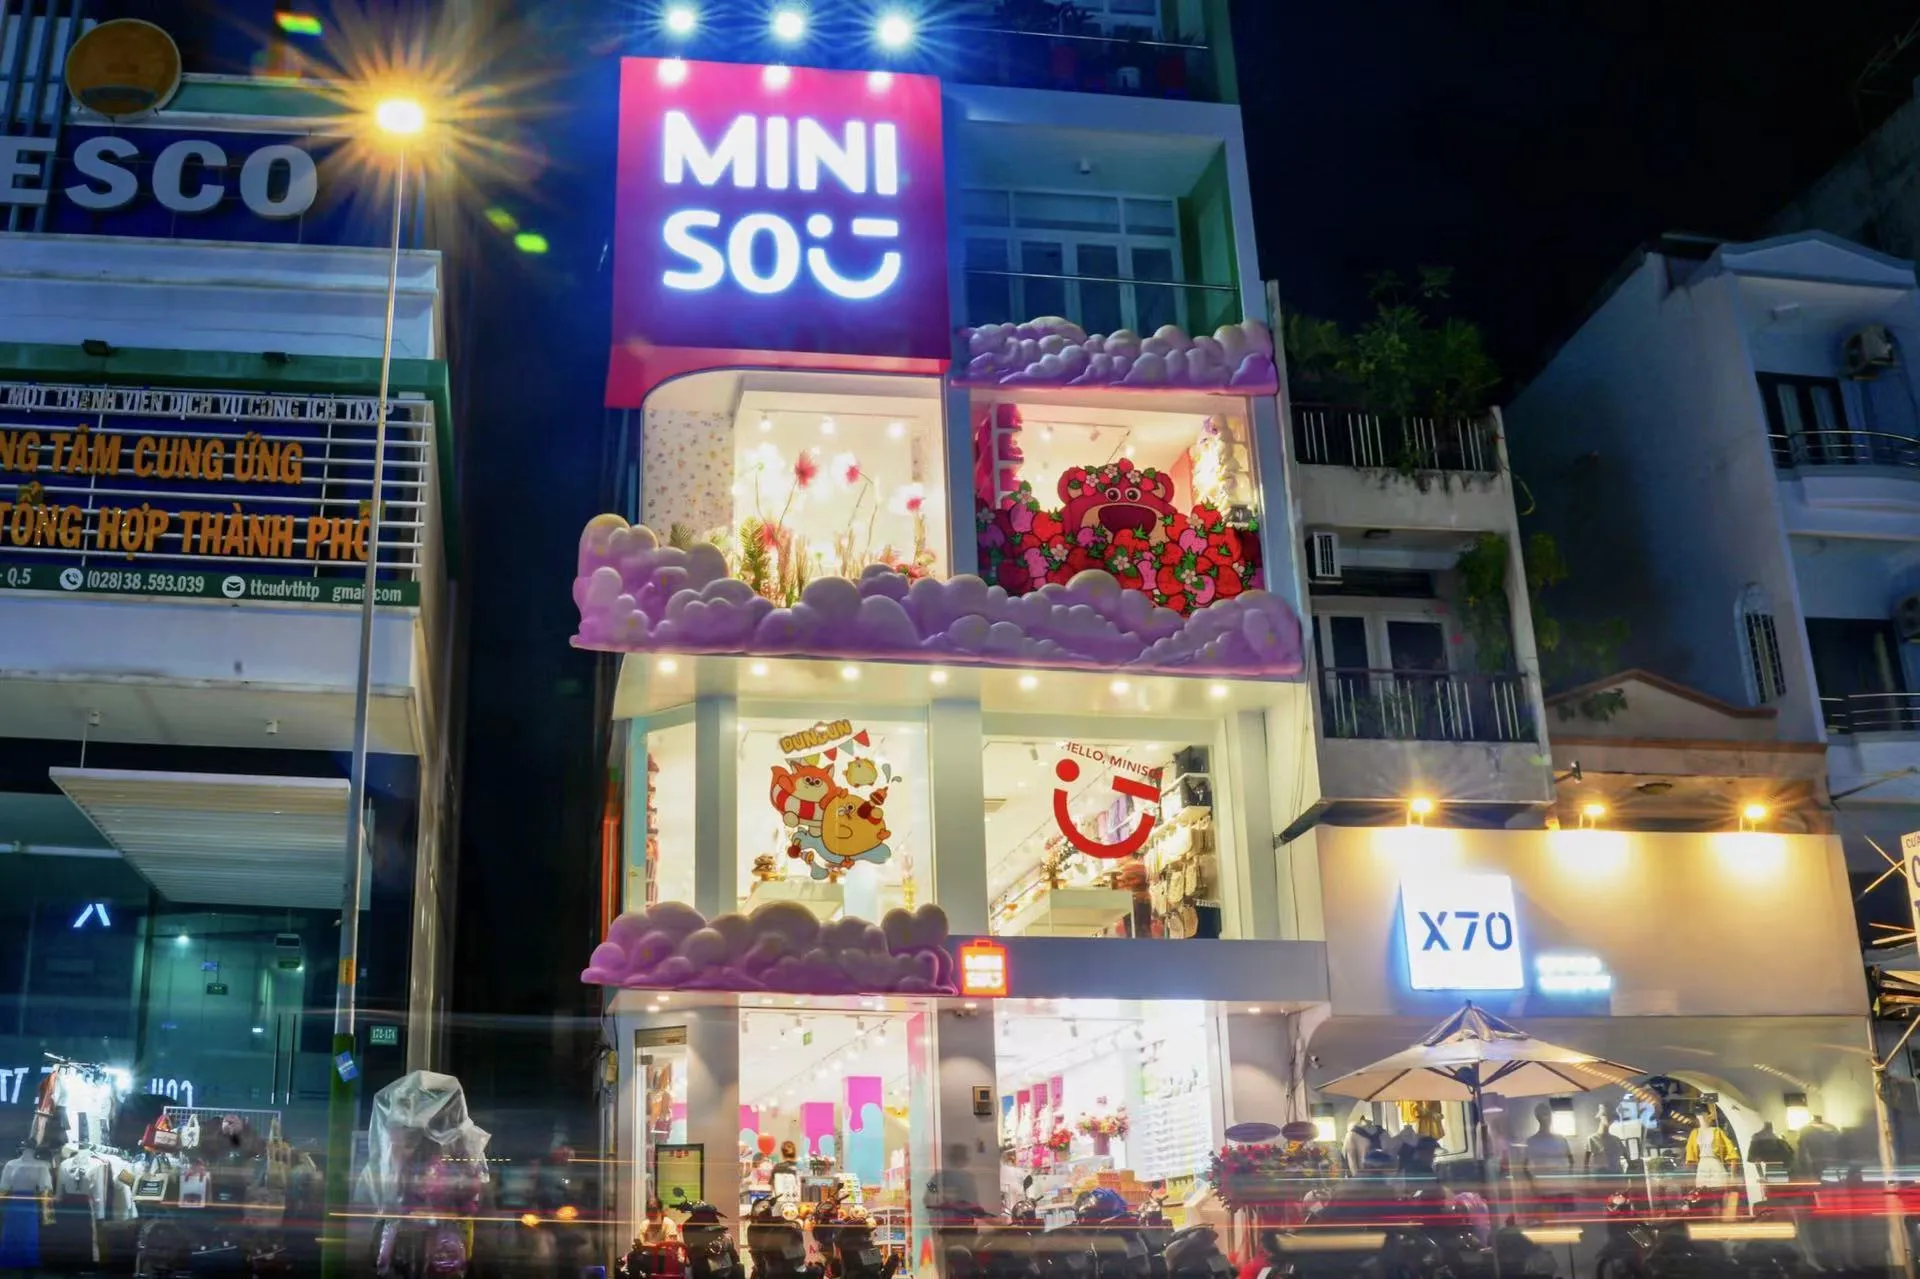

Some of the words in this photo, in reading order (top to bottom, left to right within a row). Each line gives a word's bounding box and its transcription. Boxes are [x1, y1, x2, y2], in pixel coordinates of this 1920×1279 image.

[664, 111, 898, 195] MINI
[50, 424, 121, 476] TÂM
[133, 436, 224, 481] CUNG
[234, 432, 303, 485] ỨNG
[96, 502, 169, 561] HỢP
[179, 502, 295, 557] THÀNH
[7, 567, 32, 587] Q.5
[87, 569, 205, 593] (028)38.593.039
[1418, 911, 1513, 951] X70
